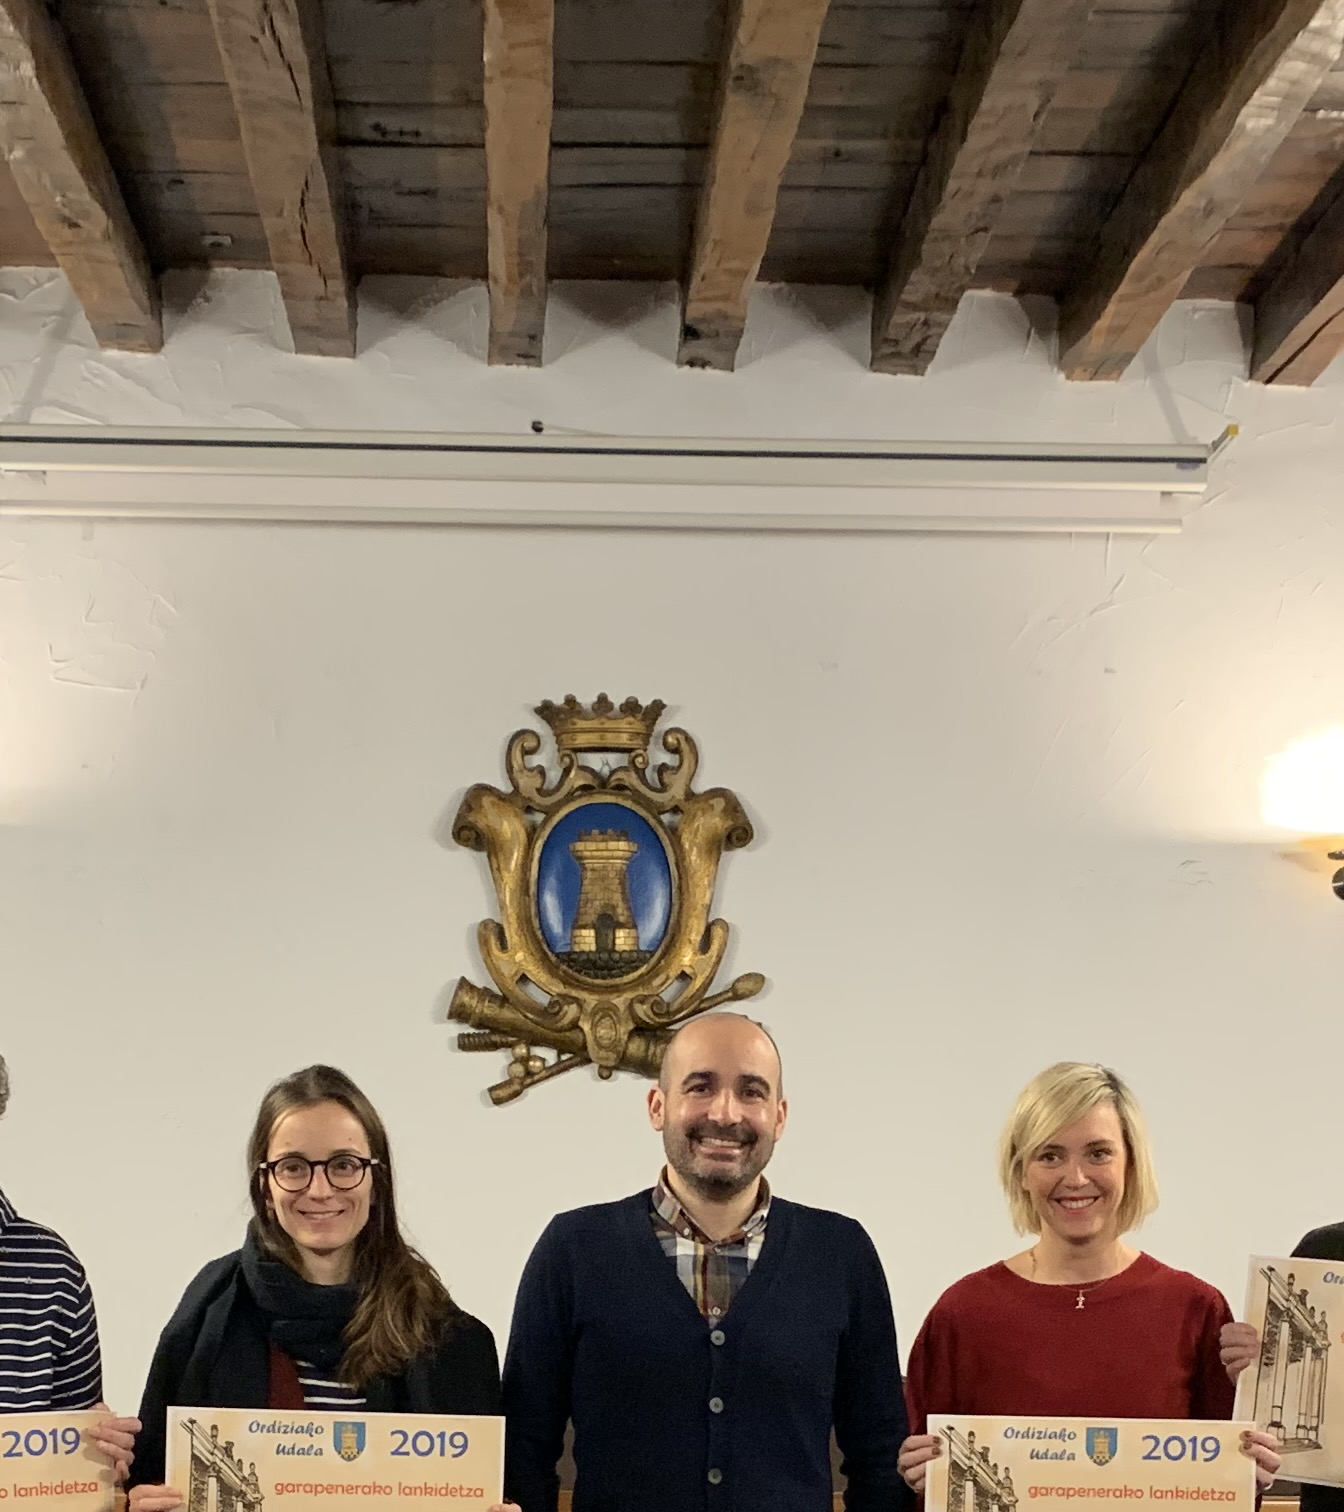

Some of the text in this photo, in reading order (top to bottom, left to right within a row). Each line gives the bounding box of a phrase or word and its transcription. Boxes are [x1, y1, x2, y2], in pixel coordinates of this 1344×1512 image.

[248, 1420, 324, 1436] Ordiziako
[1003, 1427, 1077, 1442] Ordiziako
[1, 1428, 80, 1458] 2019
[276, 1443, 324, 1457] Udala
[390, 1430, 469, 1458] 2019
[1142, 1435, 1220, 1462] 2019
[1029, 1449, 1076, 1461] Udala
[14, 1481, 98, 1499] lankidetza
[274, 1481, 484, 1498] garapenerako lankidetza
[1028, 1485, 1236, 1501] garapenerako lankidetza
